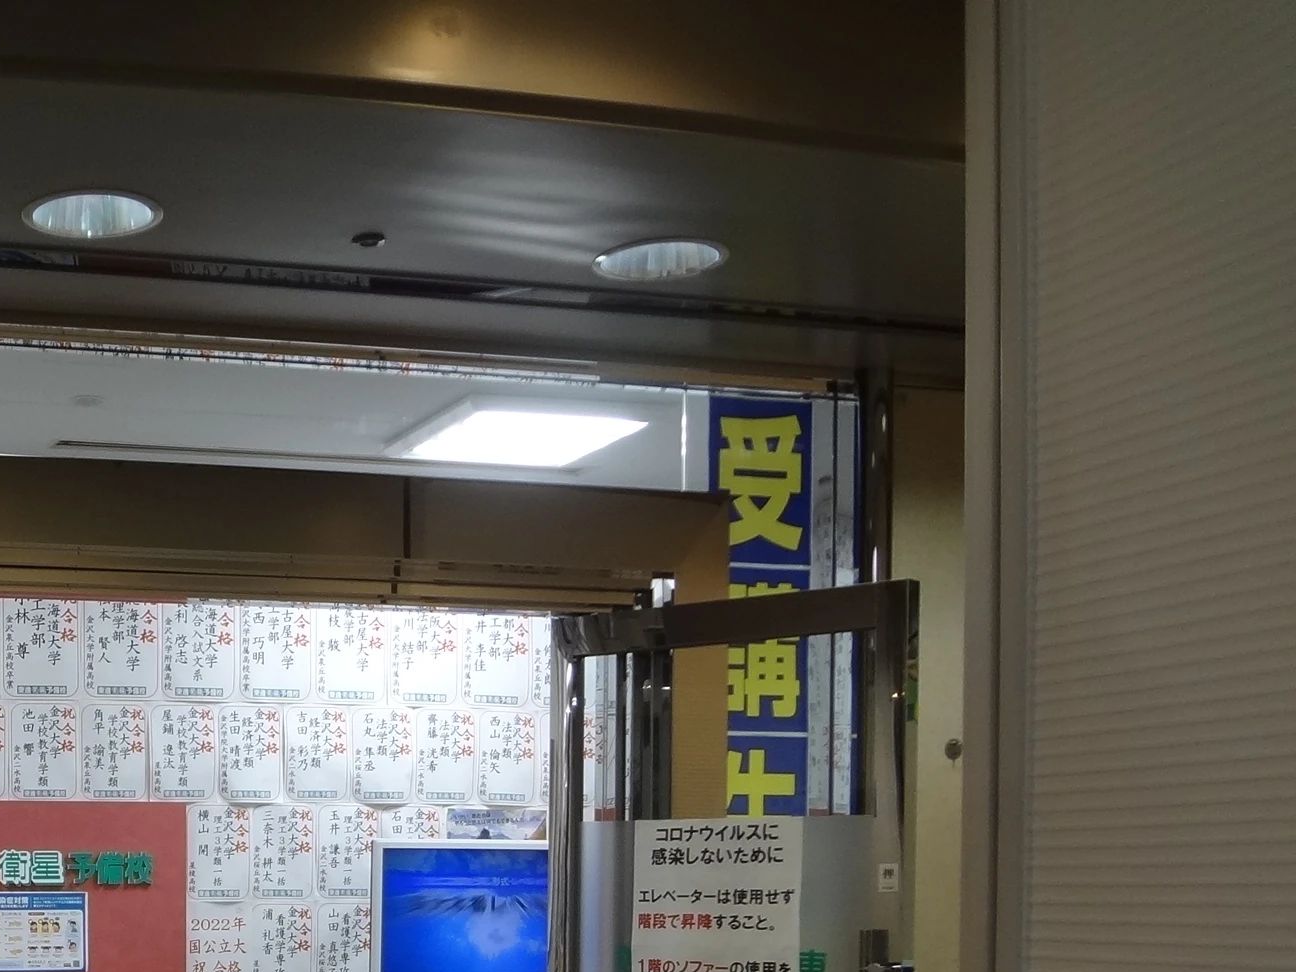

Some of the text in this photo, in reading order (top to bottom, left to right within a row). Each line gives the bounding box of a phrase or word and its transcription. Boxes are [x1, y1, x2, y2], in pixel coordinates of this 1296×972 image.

[23, 709, 35, 733] 池田
[48, 705, 61, 759] 金沢大学
[60, 708, 75, 752] 祝合格
[119, 706, 132, 759] 金沢大学
[130, 708, 144, 753] 祝合格
[188, 707, 200, 759] 金沢大学
[199, 708, 214, 753] 祝合格
[229, 711, 241, 735] 生田
[242, 717, 254, 768] 経済学類
[254, 708, 266, 760] 金沢大学
[297, 711, 309, 771] 吉田 彩乃
[309, 718, 321, 768] 経済学類
[321, 709, 333, 760] 金沢大学
[364, 713, 375, 737] 石丸
[376, 718, 388, 758] 法学類
[439, 720, 450, 758] 法学類
[489, 715, 501, 740] 西山
[502, 721, 513, 760] 法学類
[513, 713, 524, 765] 金沢大学
[38, 713, 49, 787] 学校教育学類
[107, 714, 118, 788] 学校教育学類
[177, 714, 188, 787] 学校教育学類
[198, 809, 210, 834] 横山
[223, 806, 235, 860] 金沢大学
[235, 808, 250, 854] 祝合格
[288, 807, 299, 860] 金沢大学
[299, 809, 313, 853] 祝合格
[330, 811, 340, 835] 玉井
[392, 811, 403, 834] 石田
[656, 824, 779, 842] コロナウイルスに
[652, 846, 784, 866] 感染しないために
[638, 889, 795, 905] エレベーターは使用せず
[191, 917, 247, 932] 2022年
[262, 929, 273, 955] 礼香
[287, 906, 299, 958] 金沢大学
[298, 908, 312, 951] 祝合格
[328, 908, 339, 932] 山田
[352, 905, 364, 957] 金沢大学
[638, 913, 775, 931] 階段で昇降すること。
[189, 938, 247, 955] 国公立大
